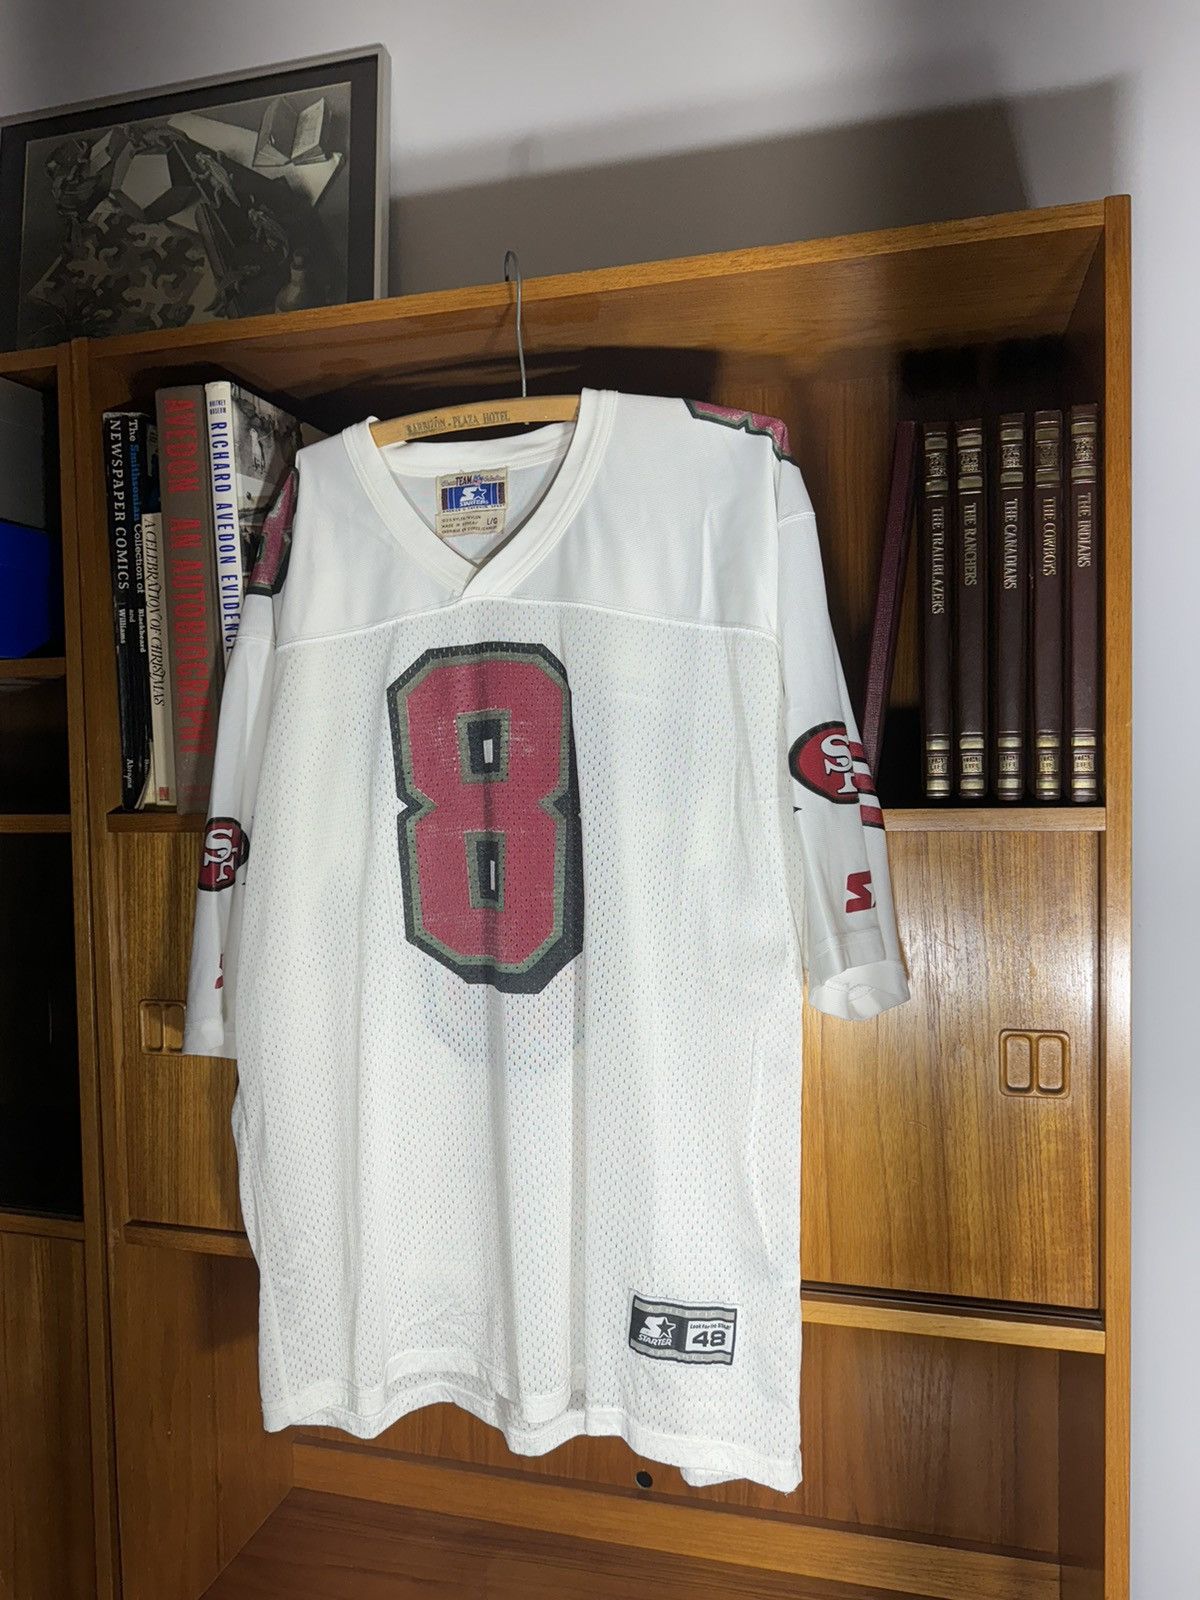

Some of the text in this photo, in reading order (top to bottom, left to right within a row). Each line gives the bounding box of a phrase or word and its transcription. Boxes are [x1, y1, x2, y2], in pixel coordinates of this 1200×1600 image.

[163, 400, 200, 494] AVEDON
[211, 421, 232, 494] RICHARD
[483, 411, 511, 425] HOTEL
[109, 420, 130, 590] NEWSPAPER COMICS
[128, 419, 145, 594] The Smithsonian Collection of
[169, 517, 203, 549] AN
[216, 503, 237, 565] AVEDON
[963, 502, 977, 586] THE RANCHERS
[1003, 498, 1018, 590] THE CANADIANS
[1042, 496, 1057, 577] THE COWBOYS
[1076, 492, 1091, 568] THE INDIANS
[931, 506, 945, 615] THE TRAILBLAZERS
[118, 608, 127, 645] Williams
[143, 518, 166, 707] A CELEBRATION OF CHRISTMAS
[170, 559, 213, 755] AUTOBIOGRAPHY
[386, 641, 585, 995] 8
[638, 1333, 673, 1347] STARTER
[692, 1330, 727, 1348] 48
